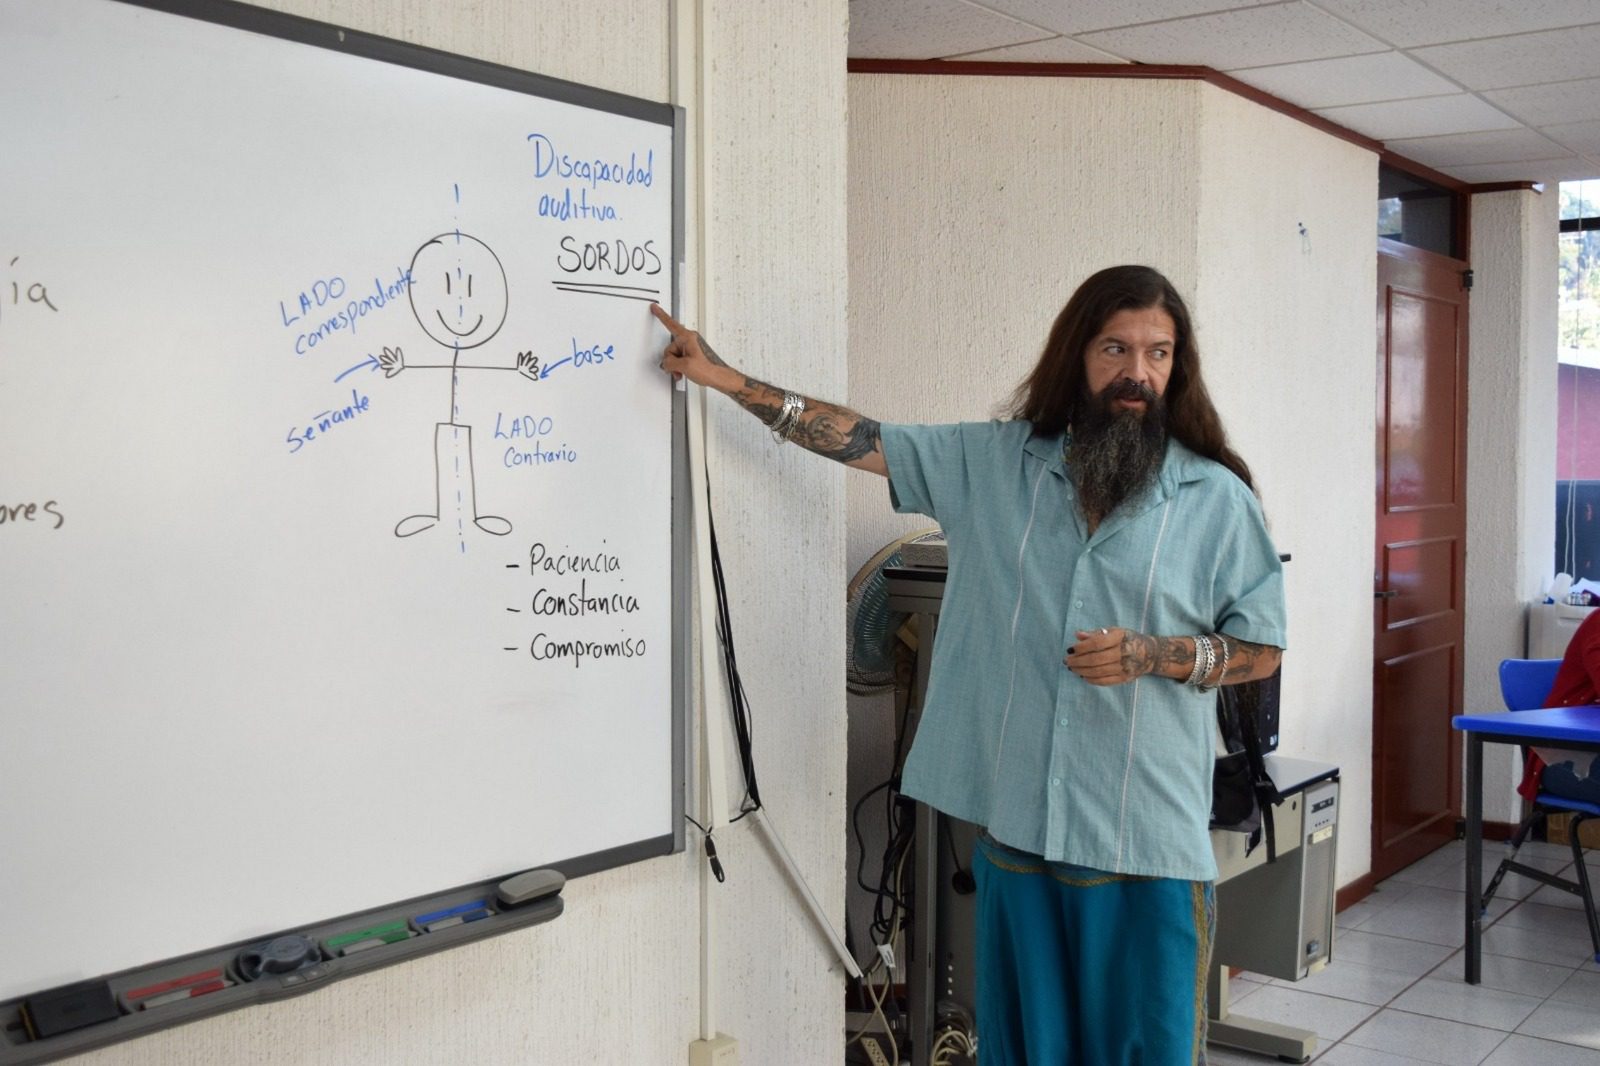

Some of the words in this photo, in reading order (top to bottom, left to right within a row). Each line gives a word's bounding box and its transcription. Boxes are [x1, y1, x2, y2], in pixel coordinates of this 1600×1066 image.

[527, 134, 653, 188] Discapacidad
[557, 236, 662, 275] SORDOS
[280, 277, 345, 327] LADO
[572, 337, 615, 368] base
[494, 412, 553, 440] LADO
[530, 540, 621, 576] Paciencia
[531, 578, 641, 616] Constancia
[530, 629, 647, 669] Compromiso
